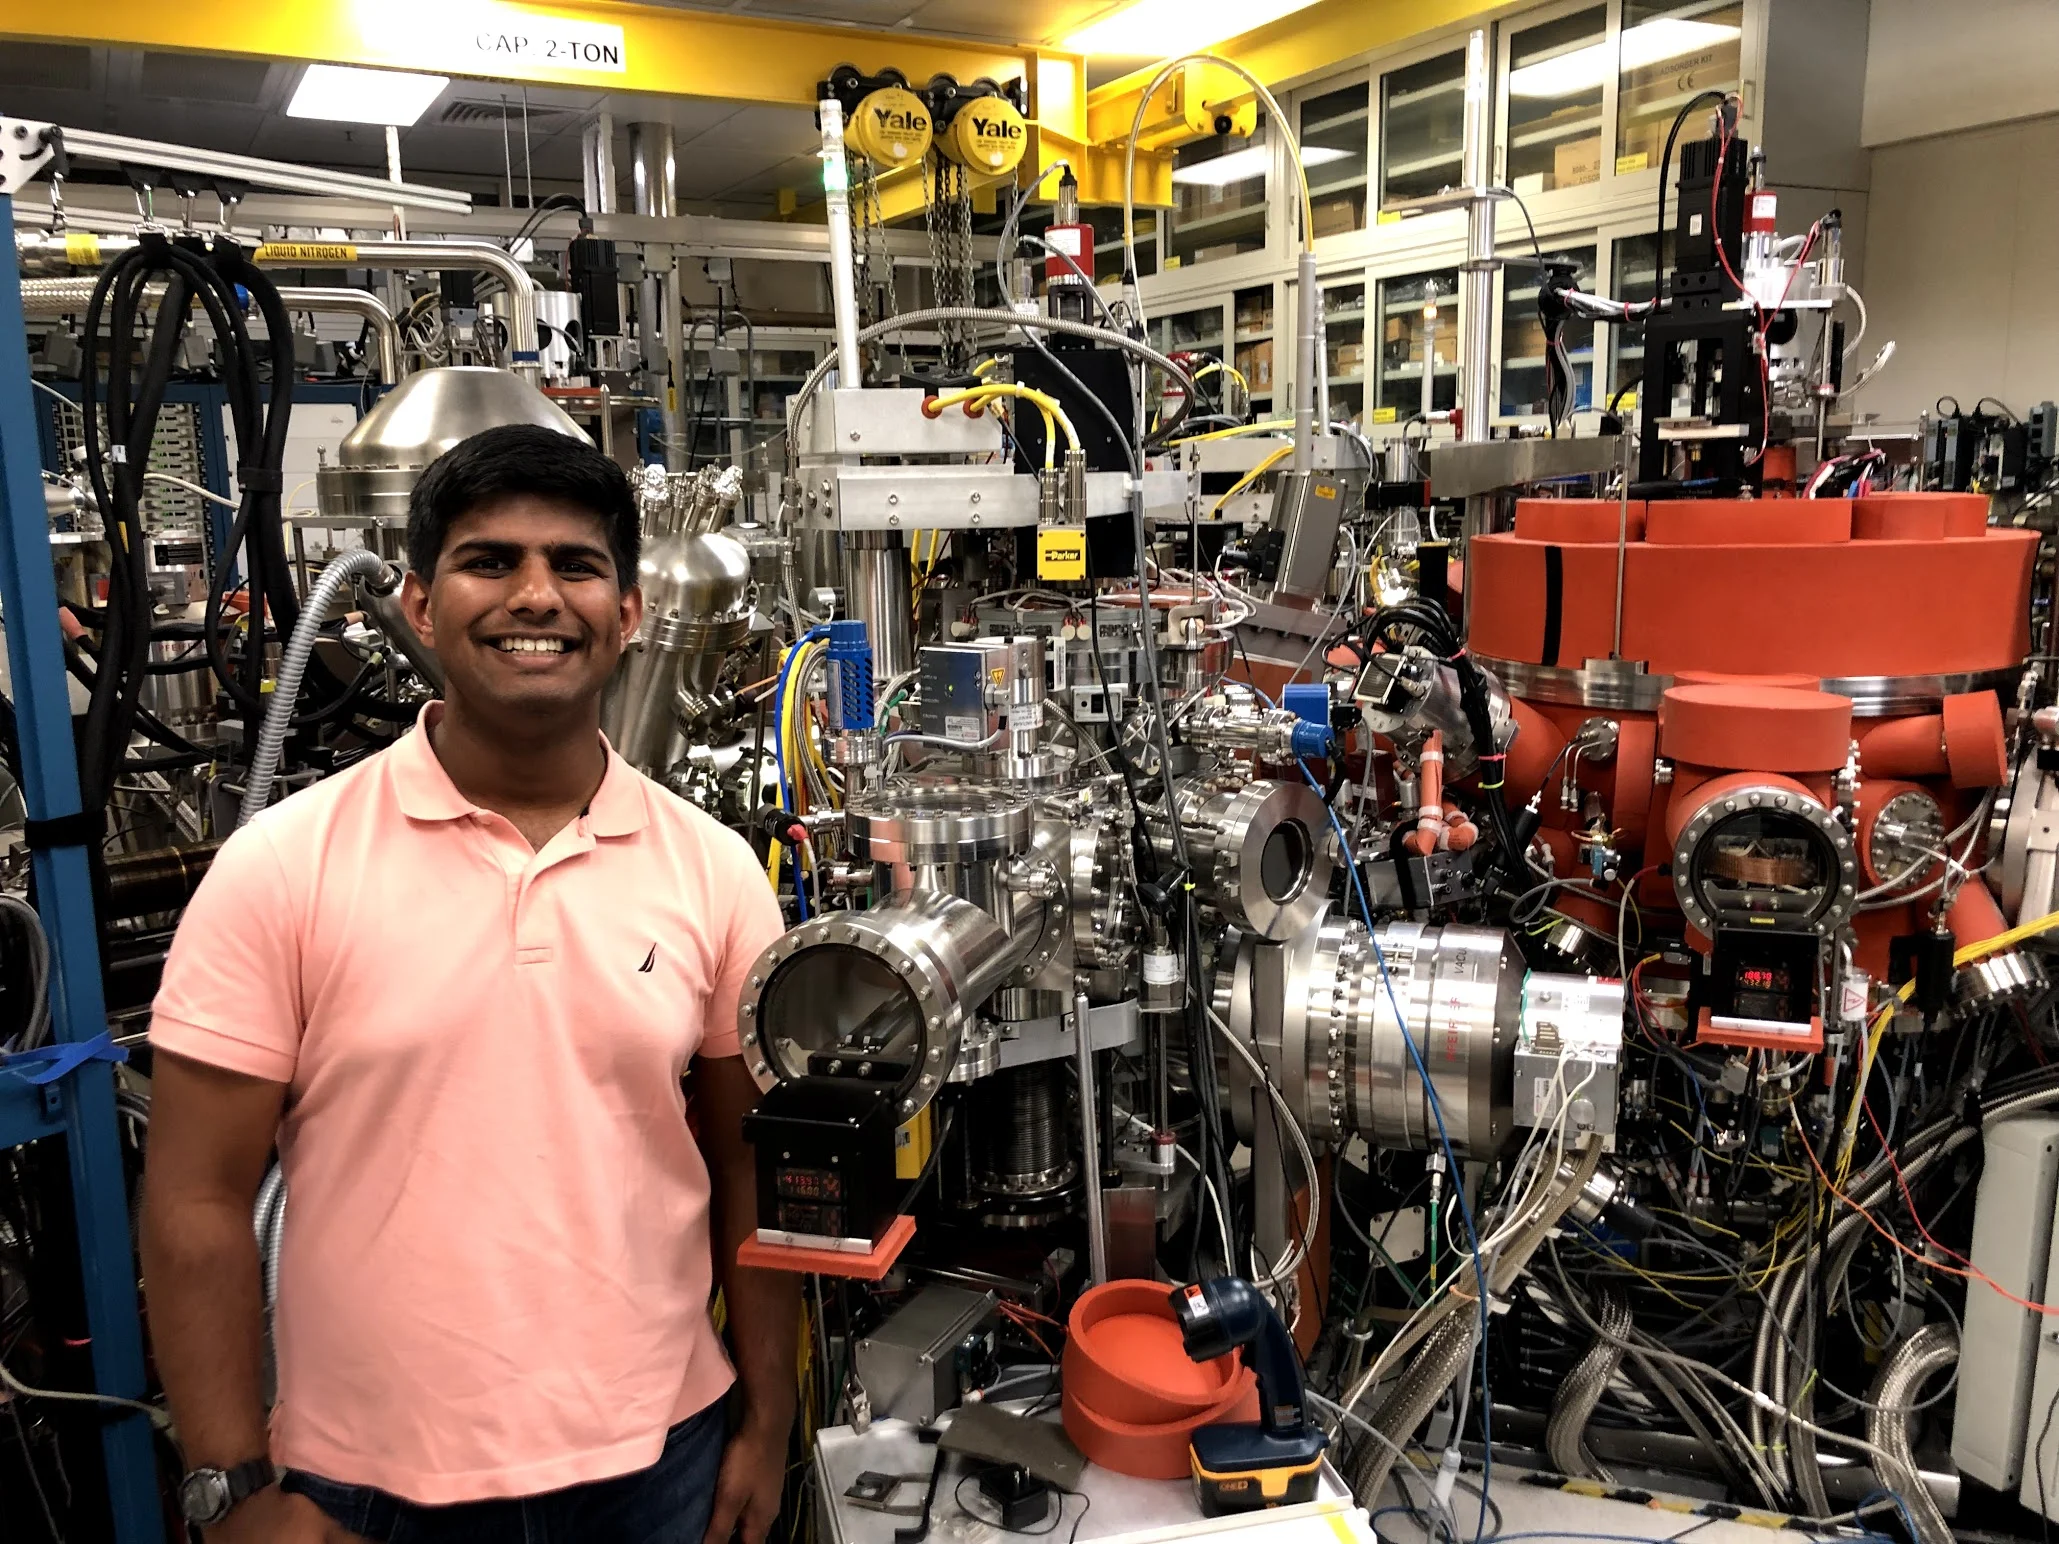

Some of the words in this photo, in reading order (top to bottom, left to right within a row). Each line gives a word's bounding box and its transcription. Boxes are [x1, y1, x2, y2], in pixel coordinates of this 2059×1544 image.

[545, 39, 618, 64] 2-TON
[1660, 58, 1699, 75] ADSORBER
[1701, 54, 1712, 65] KIT
[873, 107, 927, 131] Yale
[972, 117, 1021, 139] Yale
[265, 245, 297, 257] LIQUID
[300, 246, 347, 259] NITROGEN
[1051, 550, 1079, 561] Parker
